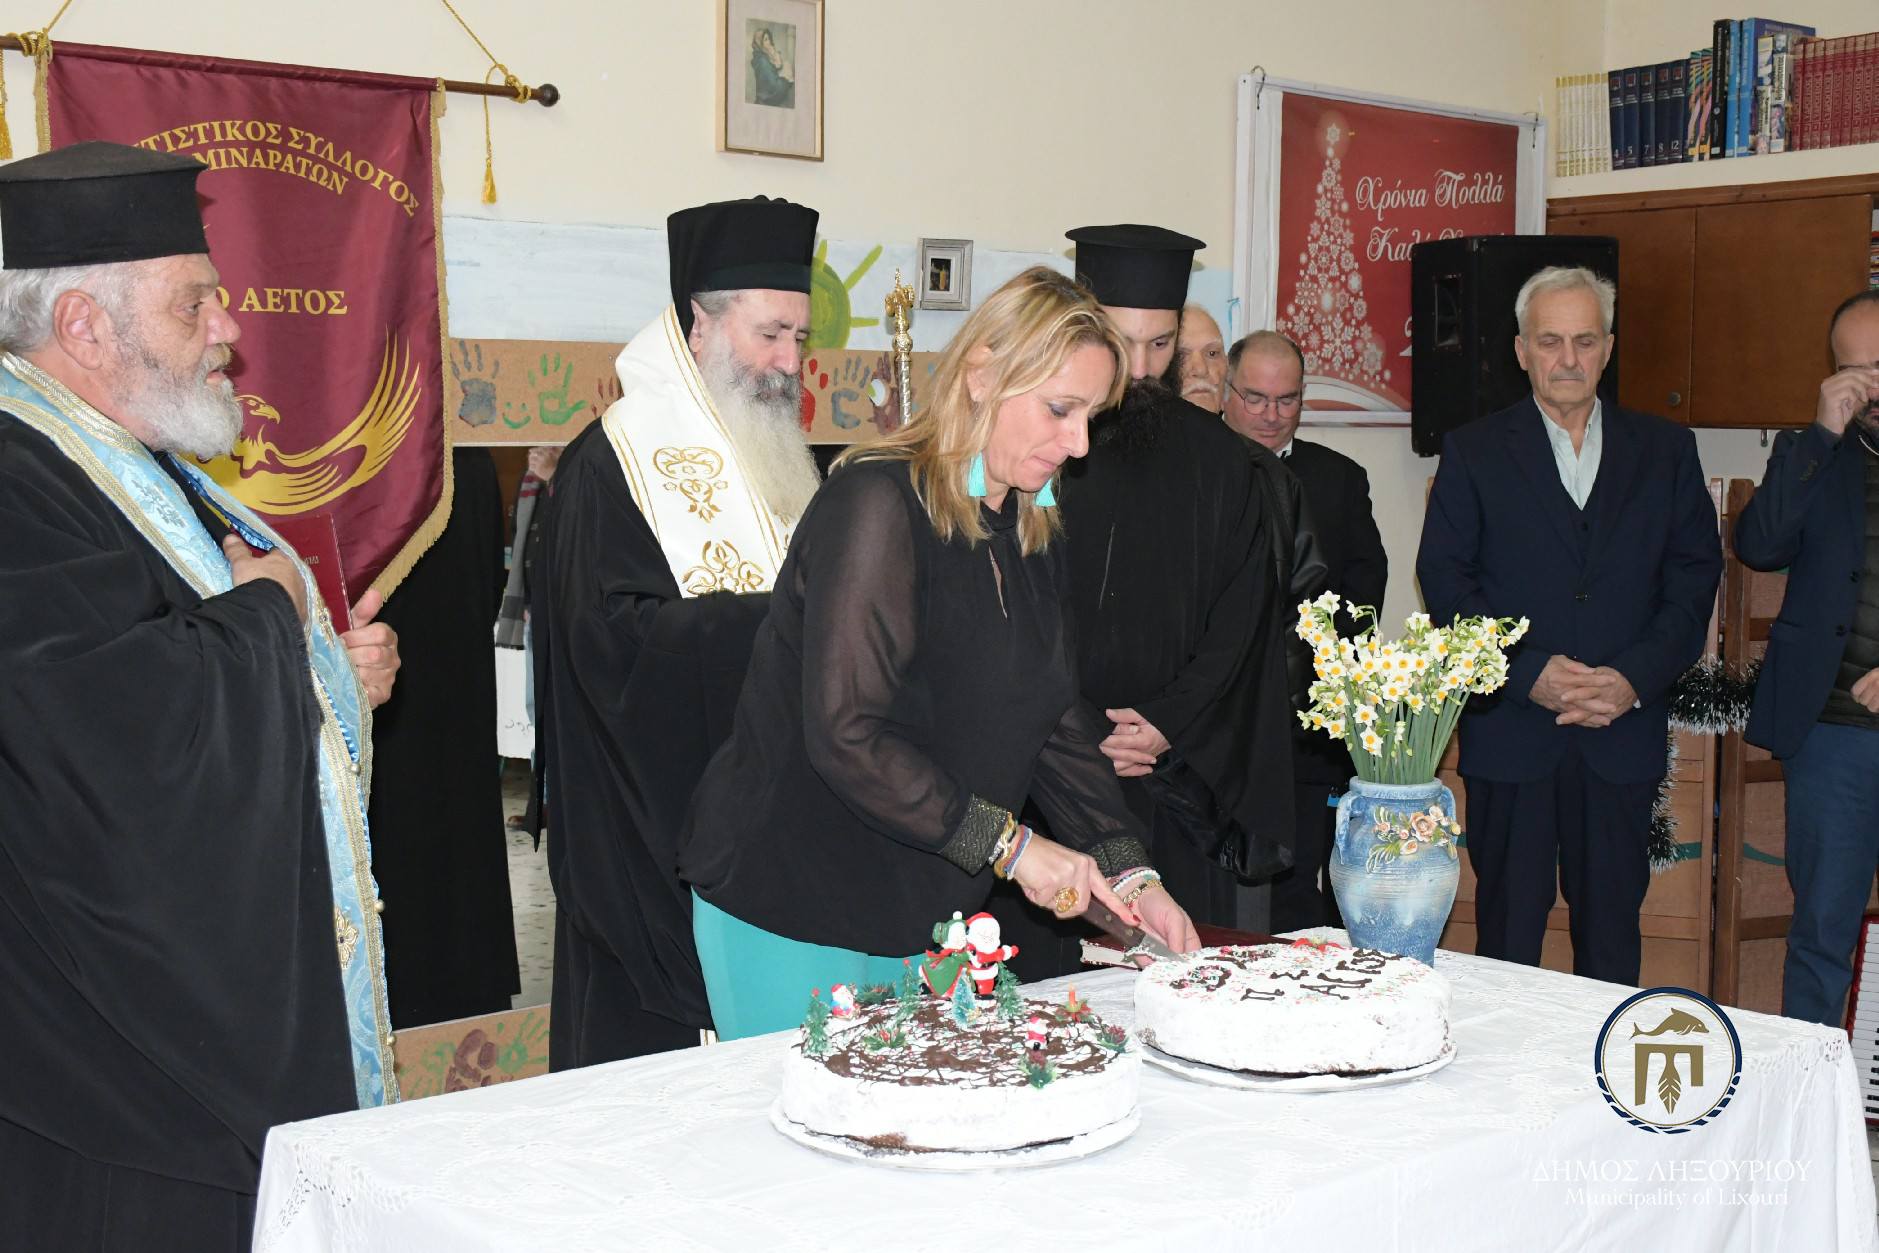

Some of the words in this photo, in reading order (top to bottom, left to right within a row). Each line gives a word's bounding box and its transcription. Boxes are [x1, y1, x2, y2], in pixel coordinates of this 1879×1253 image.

[1671, 139, 1680, 150] 12
[132, 120, 282, 153] ΤΙΣΤΙΚΟΣ
[287, 127, 420, 217] ΣΥΛΛΟΓΟΣ
[192, 147, 348, 195] ΜΙΝΑΡΑΤΩΝ
[1356, 176, 1429, 221] Χρόνια
[1435, 169, 1505, 208] Πολλά
[1366, 226, 1431, 262] Καλ
[238, 287, 348, 315] ΑΕΤΟΣ
